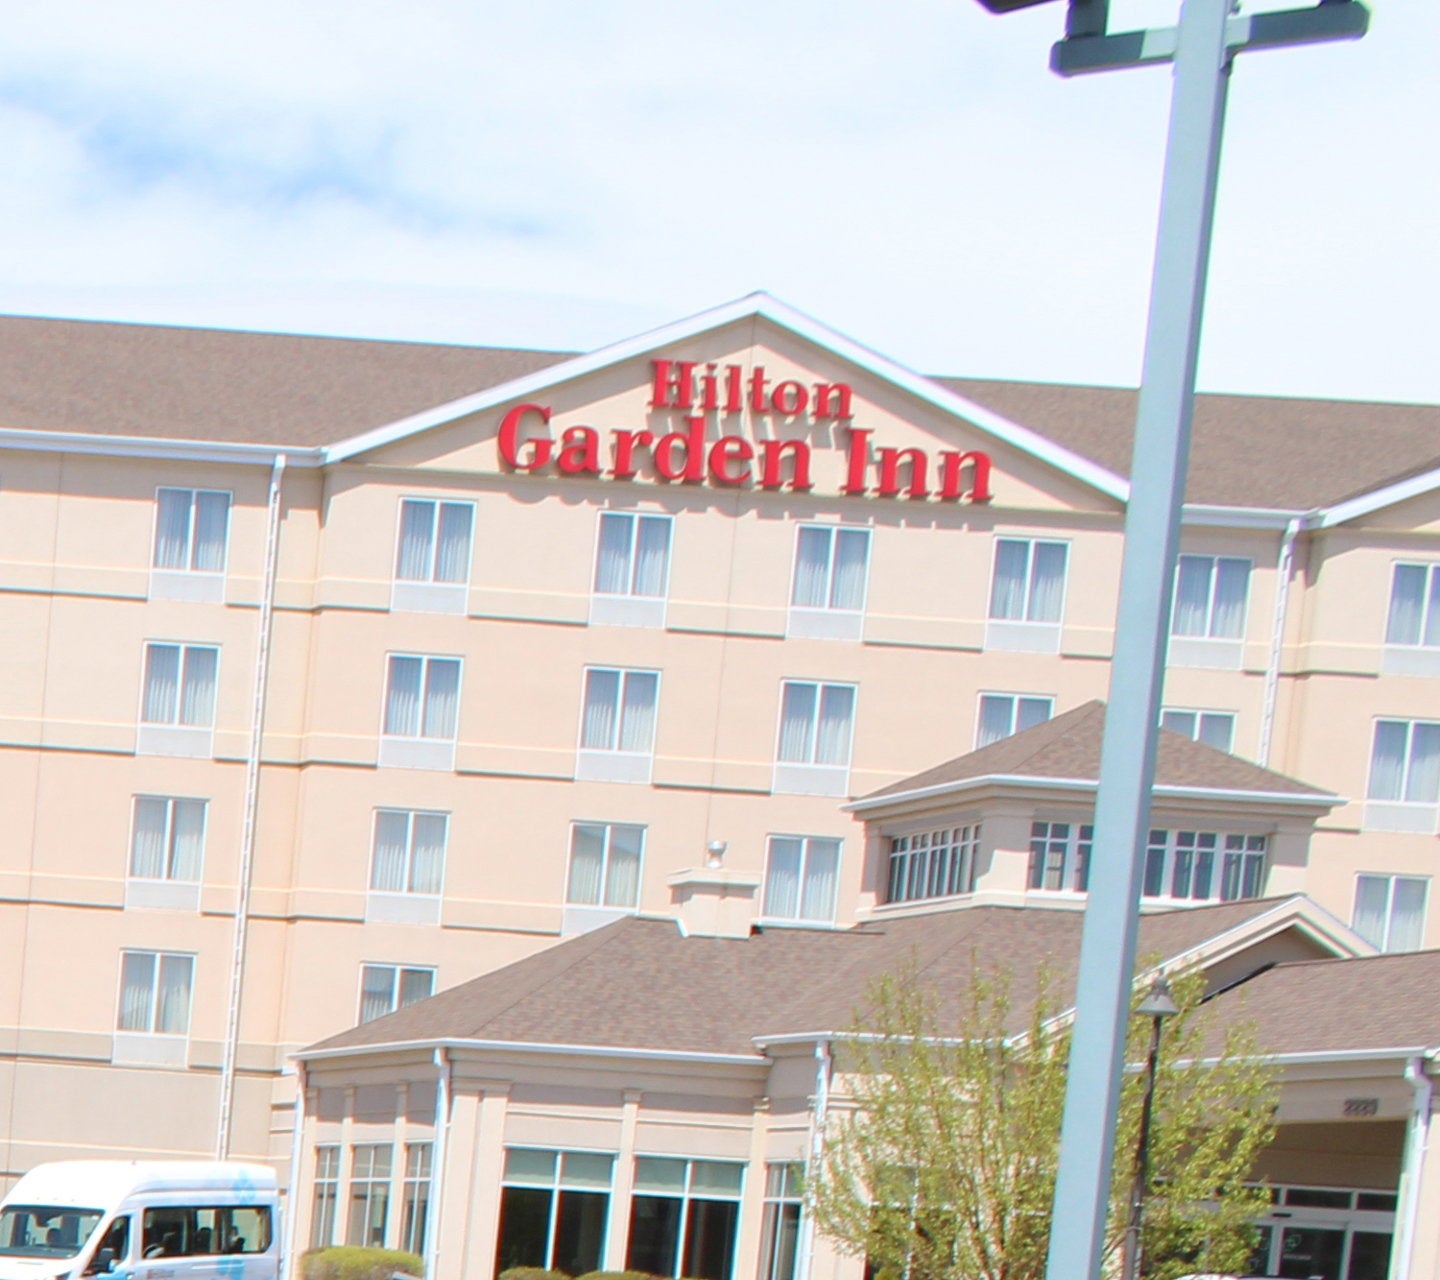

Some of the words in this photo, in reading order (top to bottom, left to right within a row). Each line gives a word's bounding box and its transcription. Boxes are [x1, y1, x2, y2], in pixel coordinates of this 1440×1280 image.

[650, 359, 855, 420] Hilton
[497, 403, 814, 490] Garden
[840, 428, 994, 501] Inn
